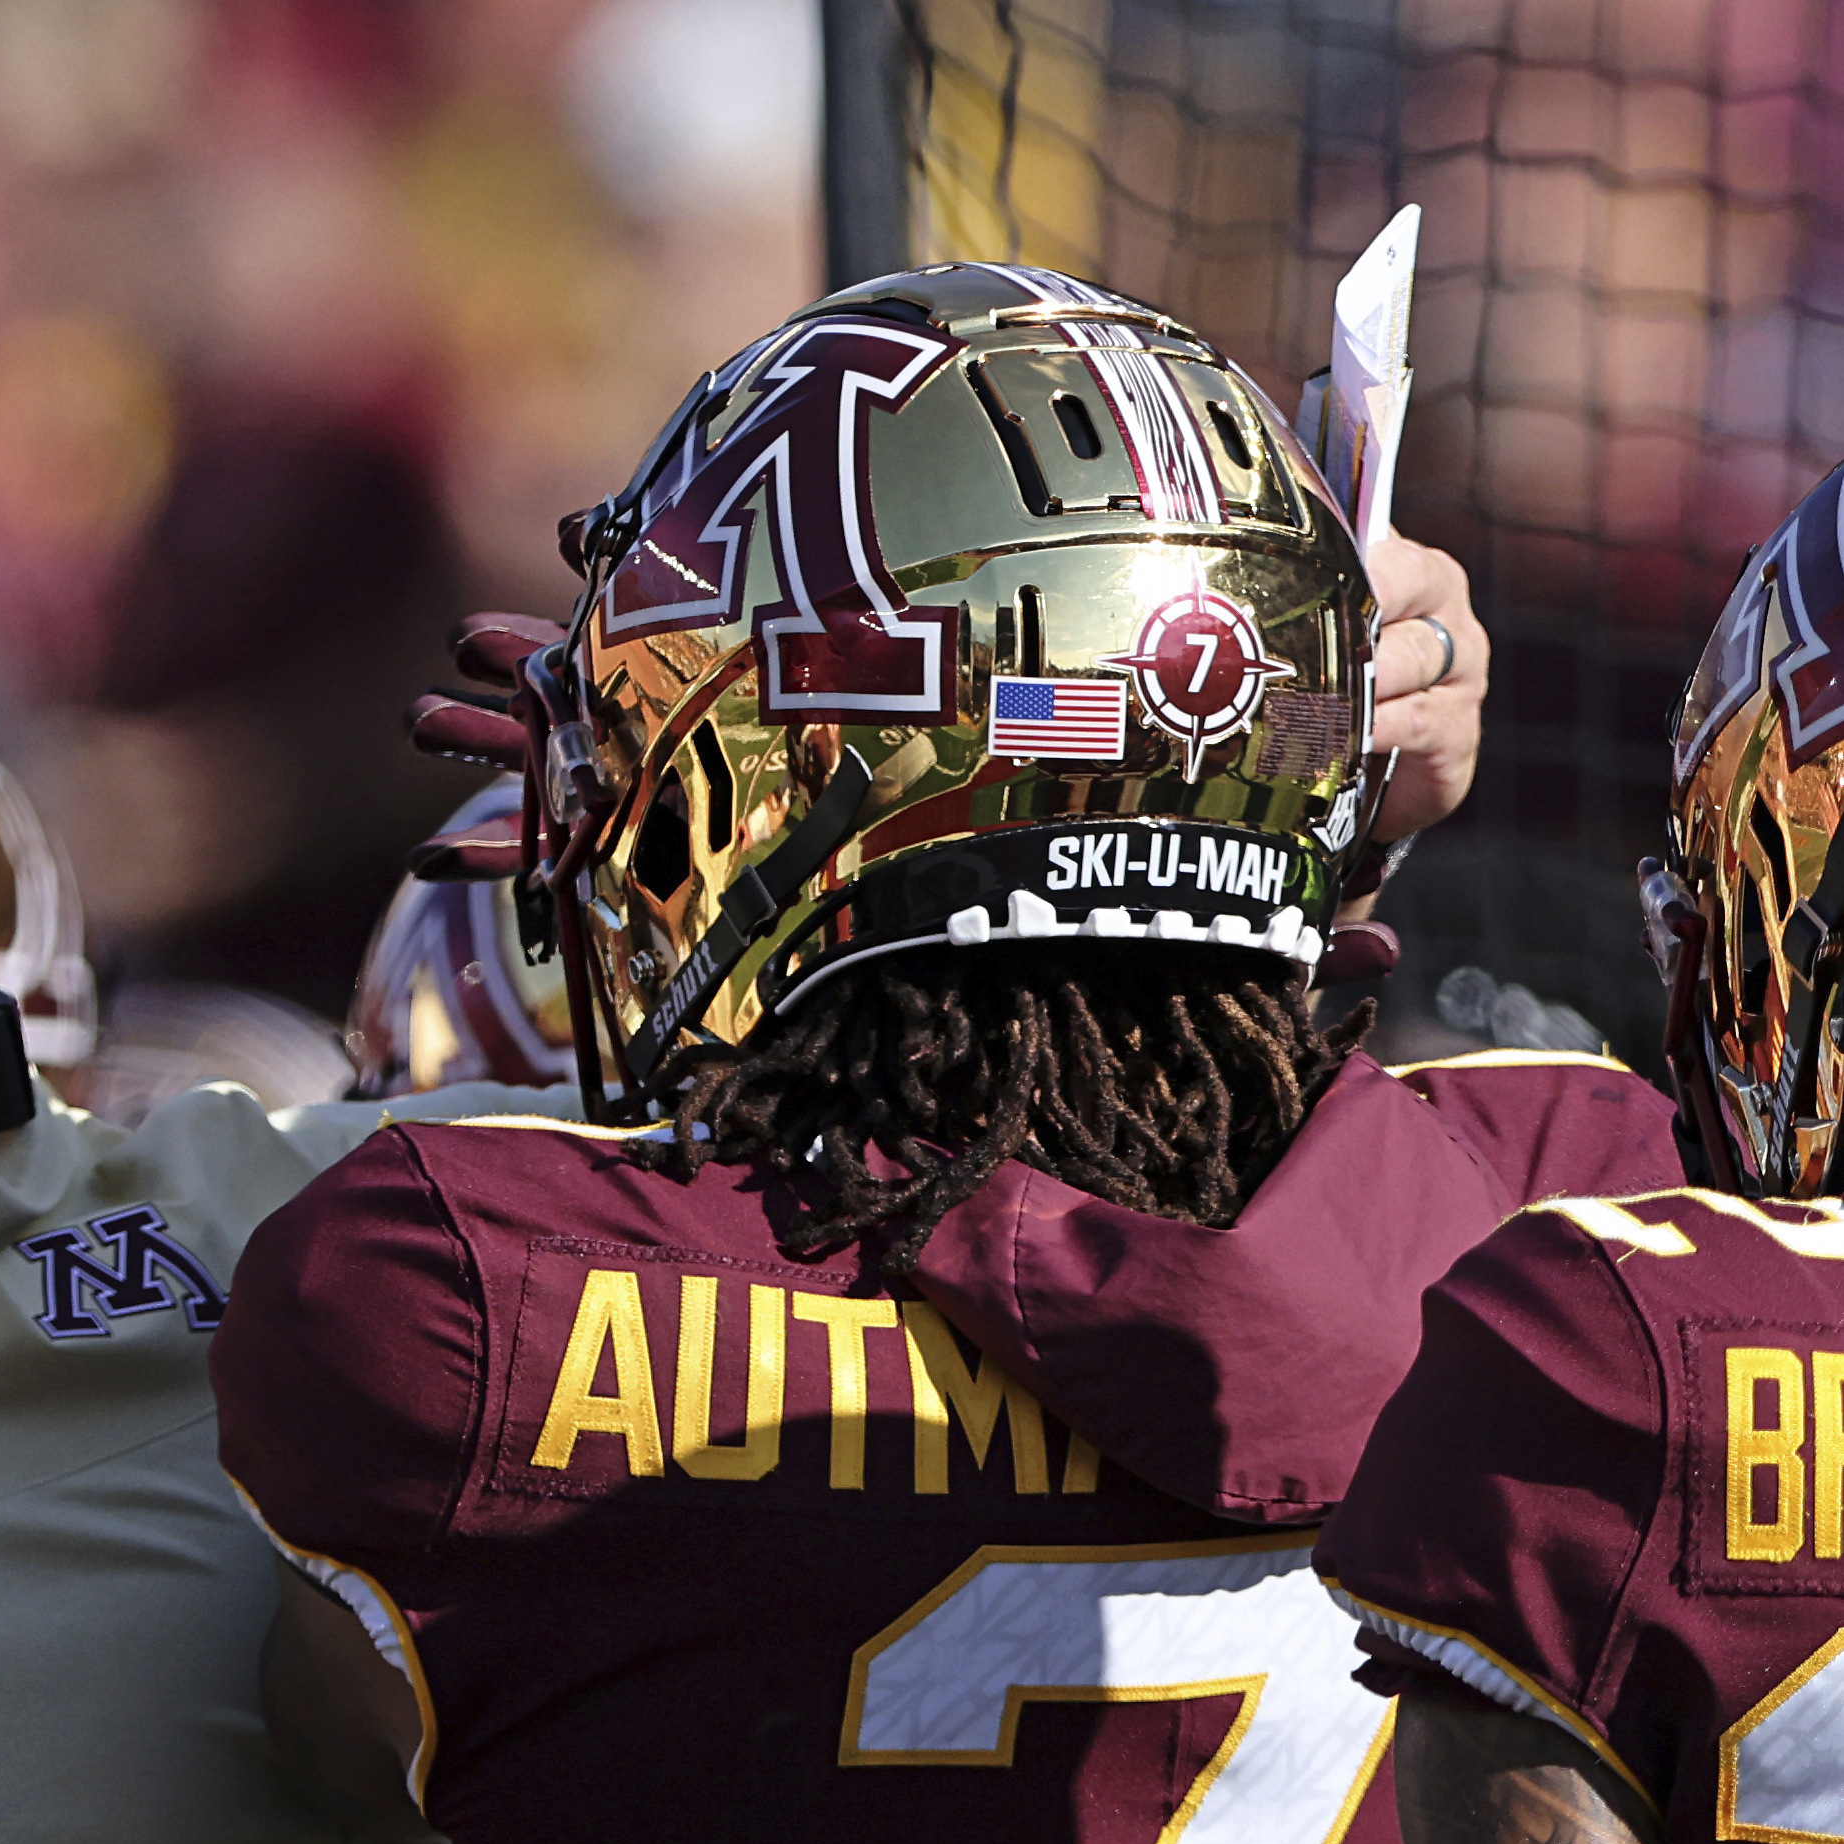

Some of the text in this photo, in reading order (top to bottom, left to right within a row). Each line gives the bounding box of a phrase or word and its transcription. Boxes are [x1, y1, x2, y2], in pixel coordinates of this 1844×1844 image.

[1185, 632, 1222, 694] 7
[1046, 832, 1289, 906] SKI-U-MAH
[530, 1268, 1101, 1495] AUTM
